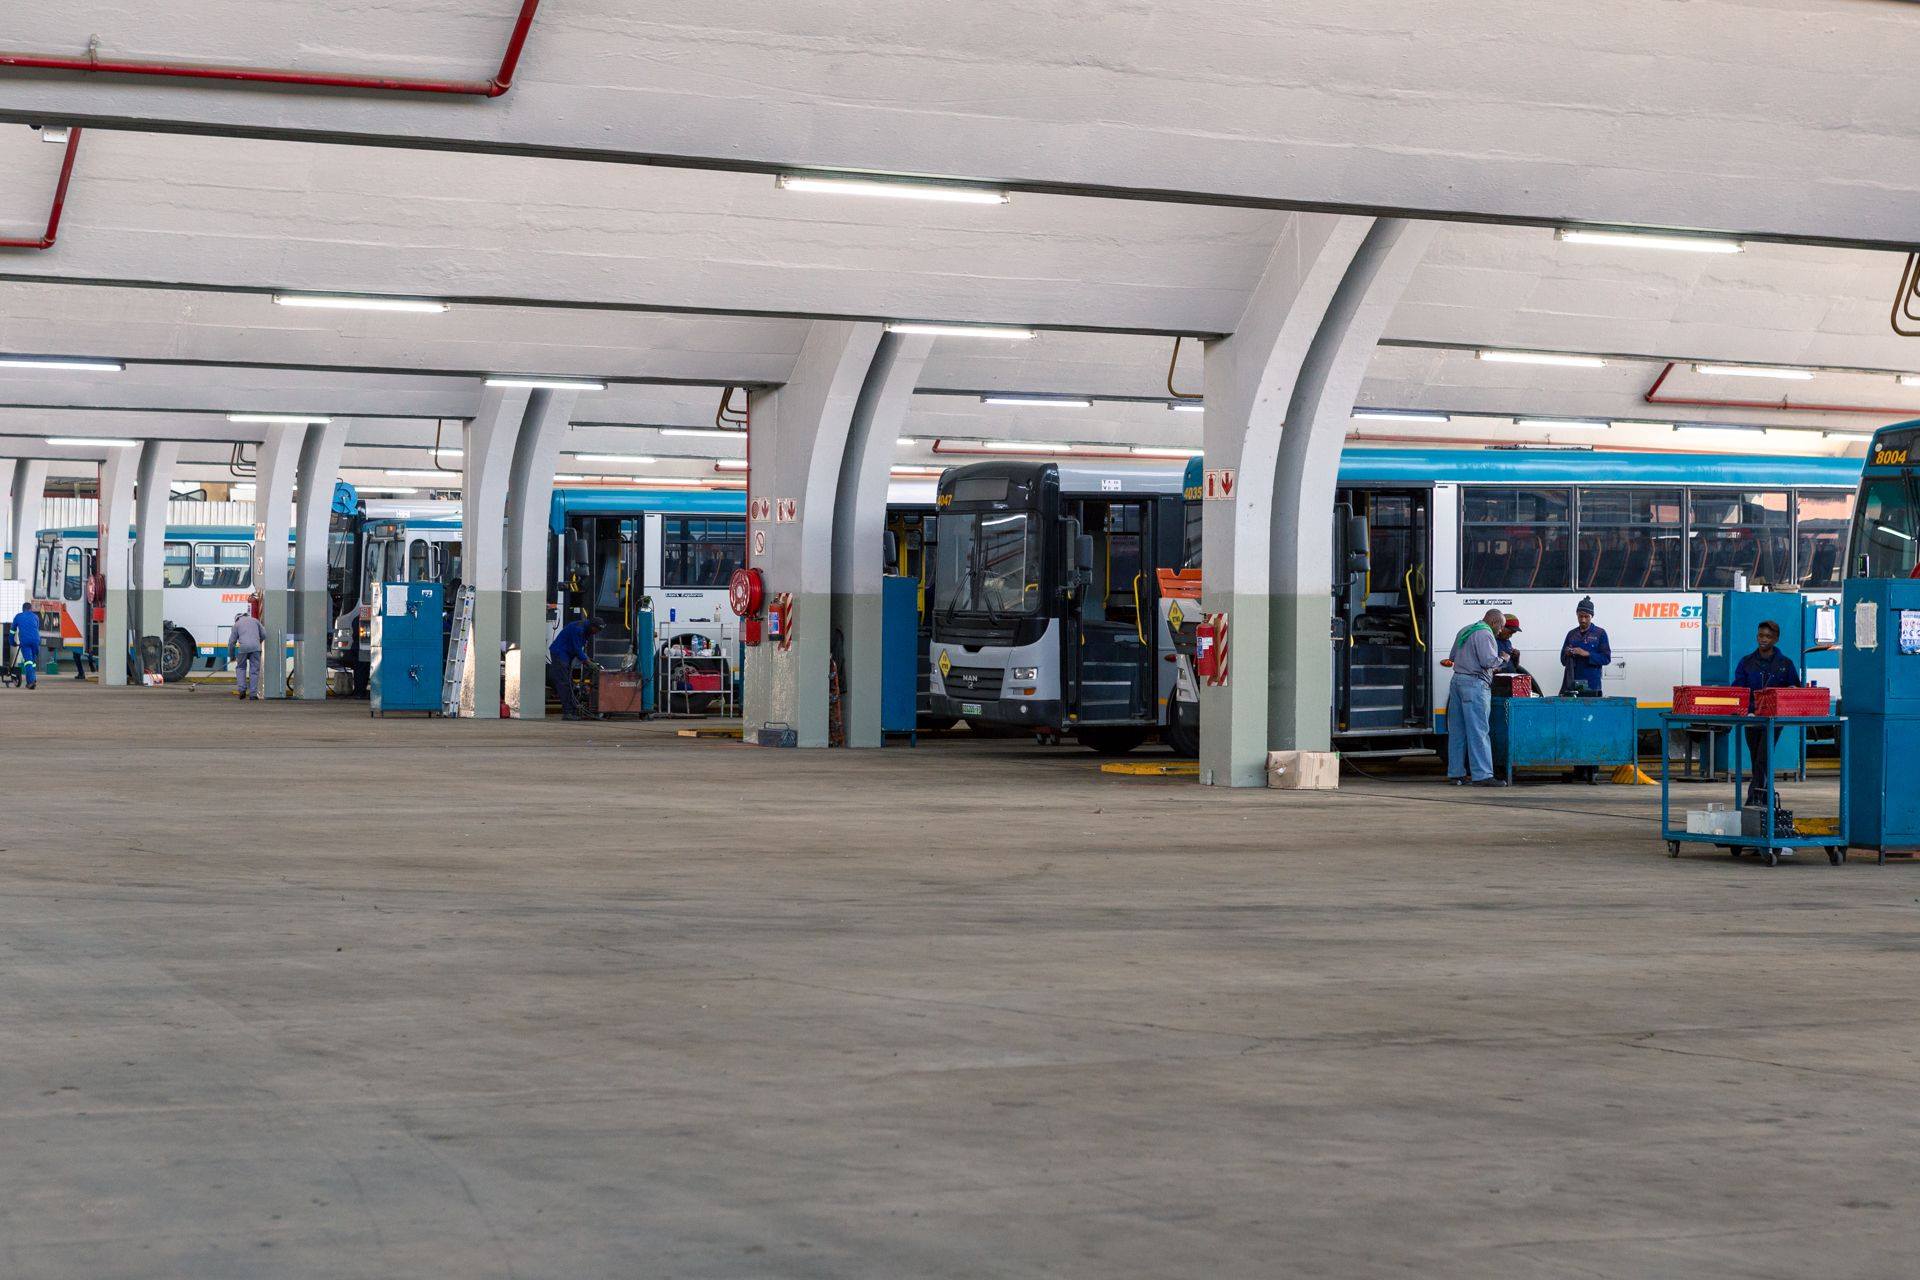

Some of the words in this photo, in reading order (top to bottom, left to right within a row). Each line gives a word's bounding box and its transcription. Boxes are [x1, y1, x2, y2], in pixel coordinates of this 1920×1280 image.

[1876, 450, 1908, 464] 8004
[1633, 603, 1680, 617] INTER
[1681, 606, 1702, 617] ST
[1680, 621, 1700, 629] BUS
